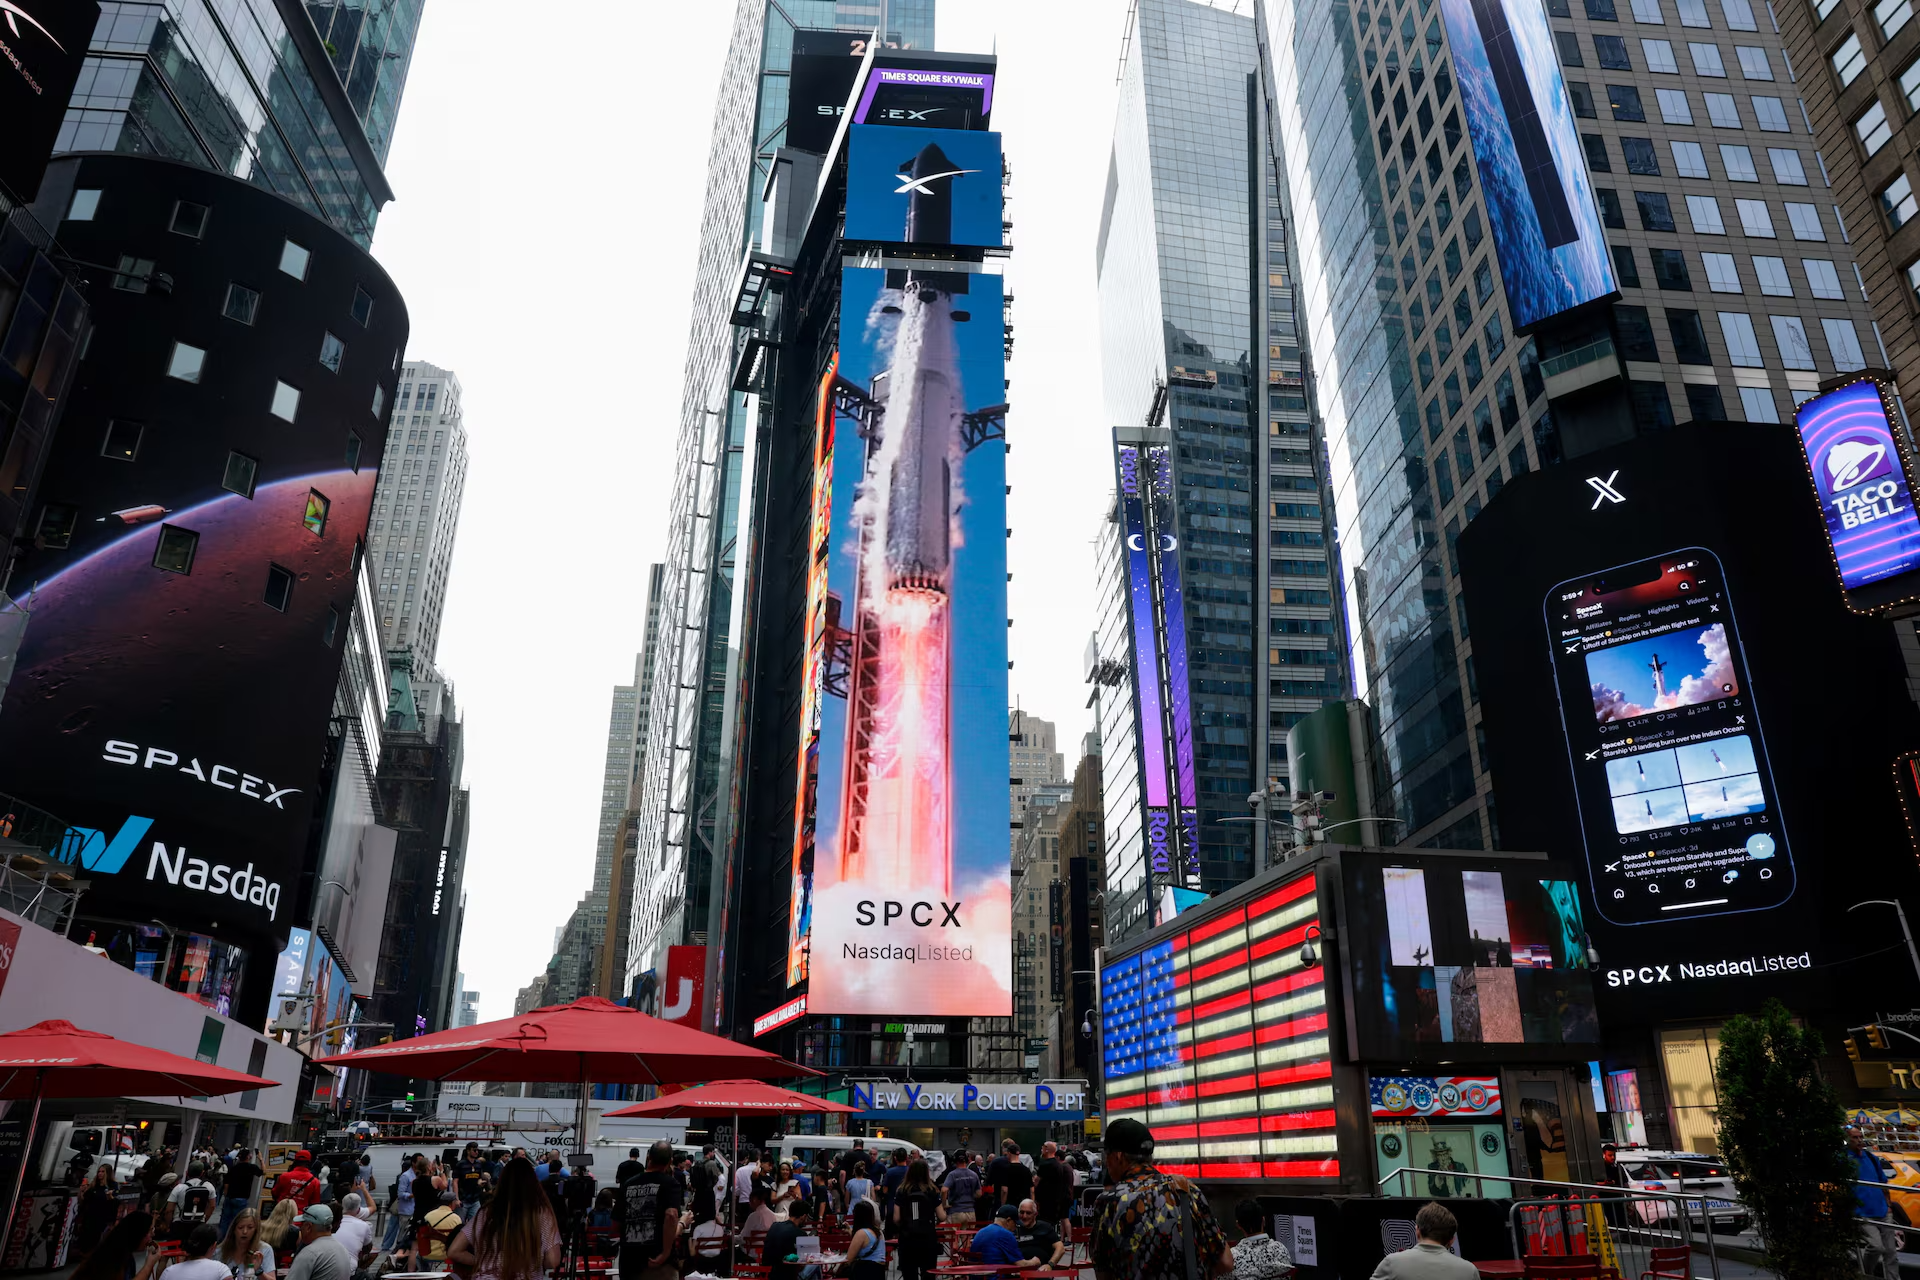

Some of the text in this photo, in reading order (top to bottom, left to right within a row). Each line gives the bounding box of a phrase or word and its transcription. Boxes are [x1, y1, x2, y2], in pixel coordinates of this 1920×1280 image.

[881, 71, 983, 85] TIMES SQUARE SKYWALK
[817, 104, 949, 121] SPEX
[1120, 449, 1138, 493] ROKU
[1831, 480, 1898, 514] TACO
[1841, 498, 1906, 530] BELL
[1561, 596, 1709, 637] Posts Affiliates Replies Highlights Videos
[1576, 602, 1603, 615] SpaceX
[1581, 631, 1605, 643] SpaceX
[1582, 639, 1601, 651] Liftoff
[1607, 633, 1633, 645] Starship
[1649, 623, 1671, 633] twelfth
[1670, 620, 1687, 630] flight
[1687, 617, 1700, 625] test
[1601, 739, 1626, 750] SpaceX
[1602, 748, 1629, 758] Starship
[1628, 744, 1638, 752] V3
[1637, 740, 1661, 750] landing
[1675, 736, 1690, 744] over
[1701, 729, 1722, 738] Indian
[1722, 725, 1745, 734] Ocean
[102, 739, 304, 810] SPACEX
[1150, 812, 1169, 873] ROKU
[1621, 851, 1648, 862] SpaceX
[1623, 860, 1652, 870] Onboard
[1651, 857, 1670, 866] views
[1669, 855, 1686, 863] from
[1685, 850, 1714, 861] Starship
[1714, 848, 1728, 856] and
[1636, 868, 1656, 877] which
[1666, 861, 1698, 872] equipped
[1697, 859, 1713, 868] with
[1712, 855, 1745, 866] upgraded
[145, 841, 281, 922] Nasdaq
[855, 900, 962, 928] SPCX
[1606, 964, 1673, 988] SPCX
[1664, 1048, 1690, 1056] campus
[714, 1131, 748, 1143] tims
[5, 1197, 34, 1267] CHICAGO
